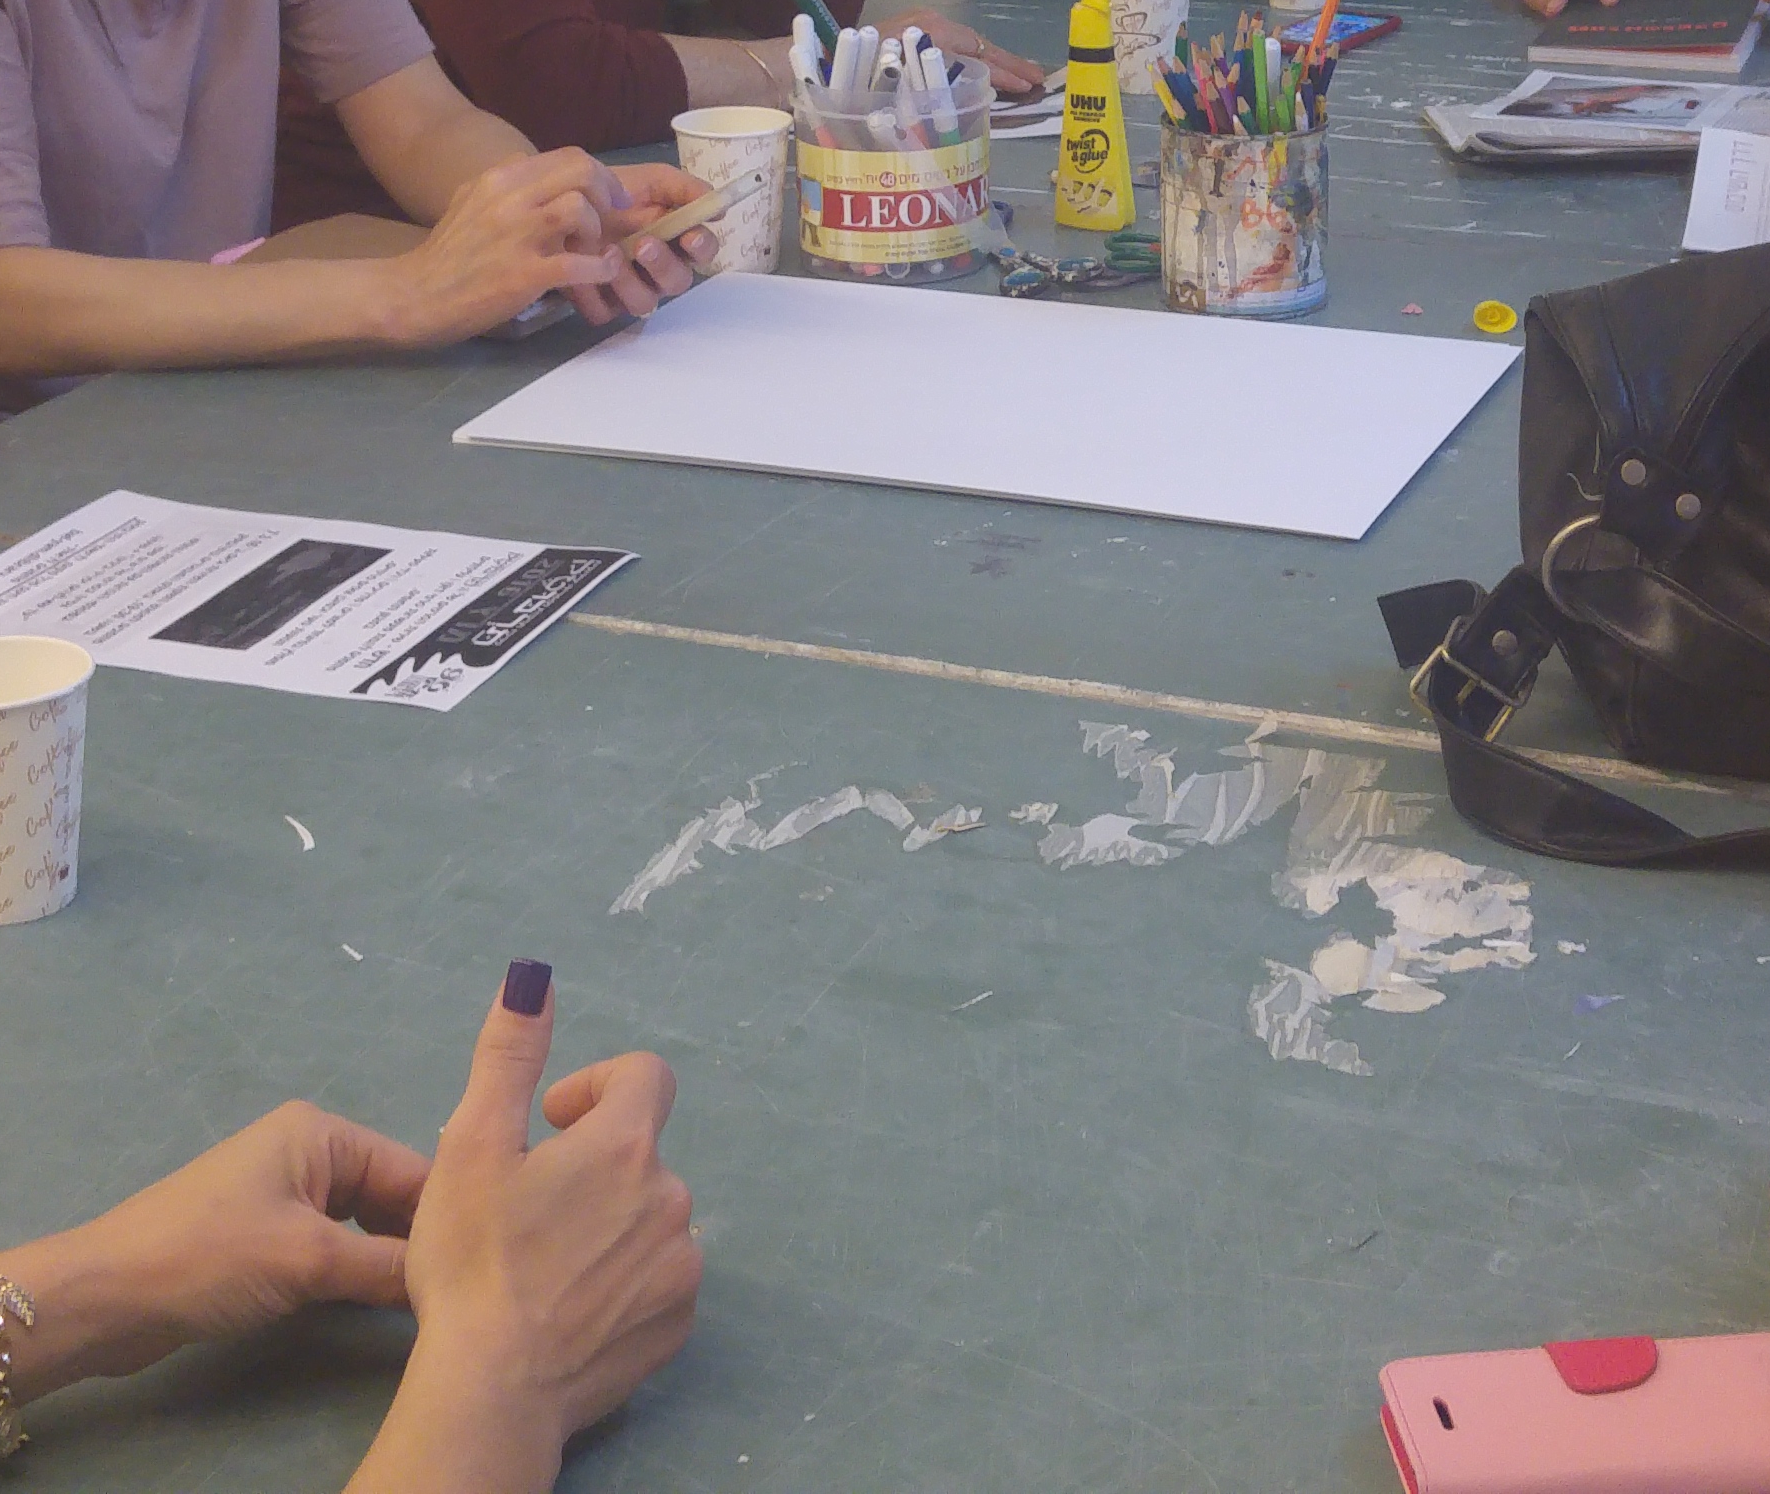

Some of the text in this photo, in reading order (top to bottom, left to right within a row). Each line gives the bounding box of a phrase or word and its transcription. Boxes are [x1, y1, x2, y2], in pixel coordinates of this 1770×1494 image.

[1070, 94, 1106, 111] UHU
[1067, 137, 1096, 151] twist
[1079, 148, 1108, 167] glue
